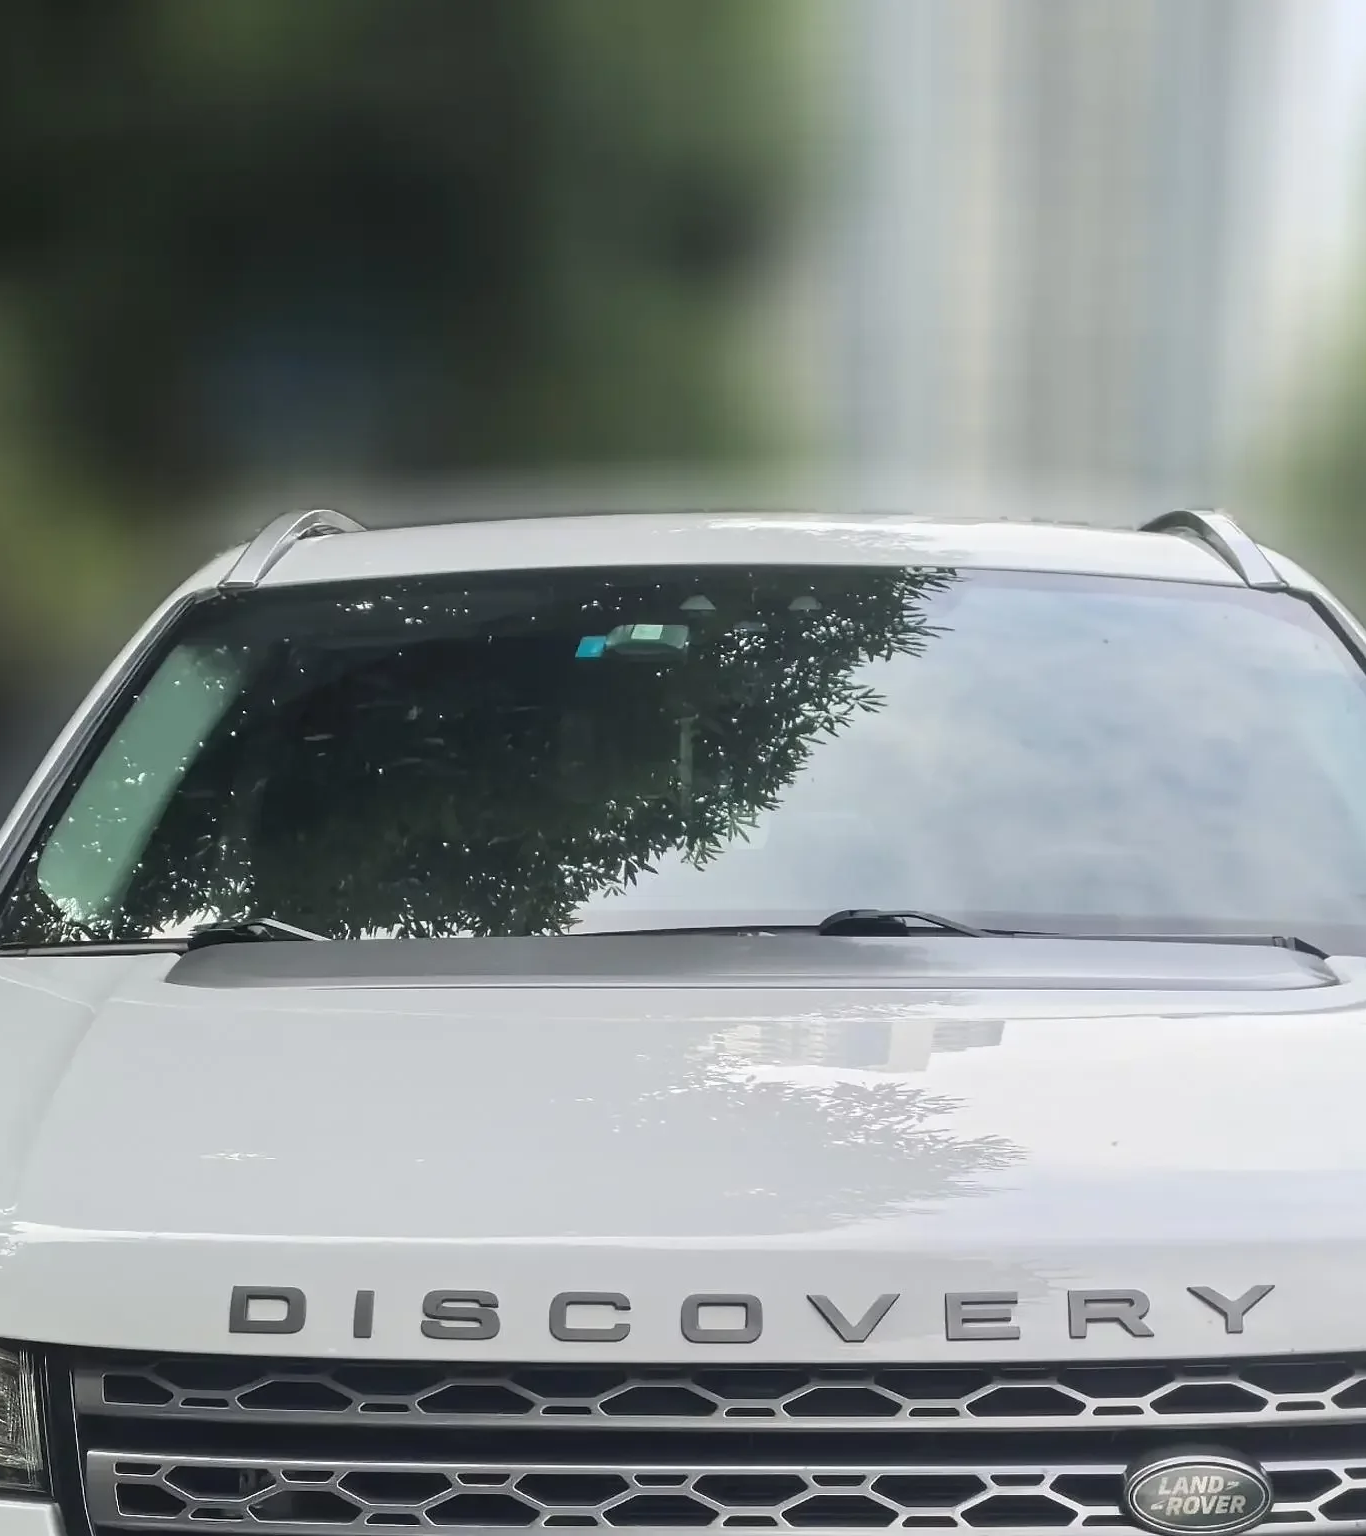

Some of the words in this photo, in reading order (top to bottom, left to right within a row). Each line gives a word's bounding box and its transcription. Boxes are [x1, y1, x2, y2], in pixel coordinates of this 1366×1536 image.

[229, 1284, 1276, 1344] DISCOVERY
[1158, 1475, 1224, 1496] LAND
[1164, 1494, 1247, 1516] ROVER
